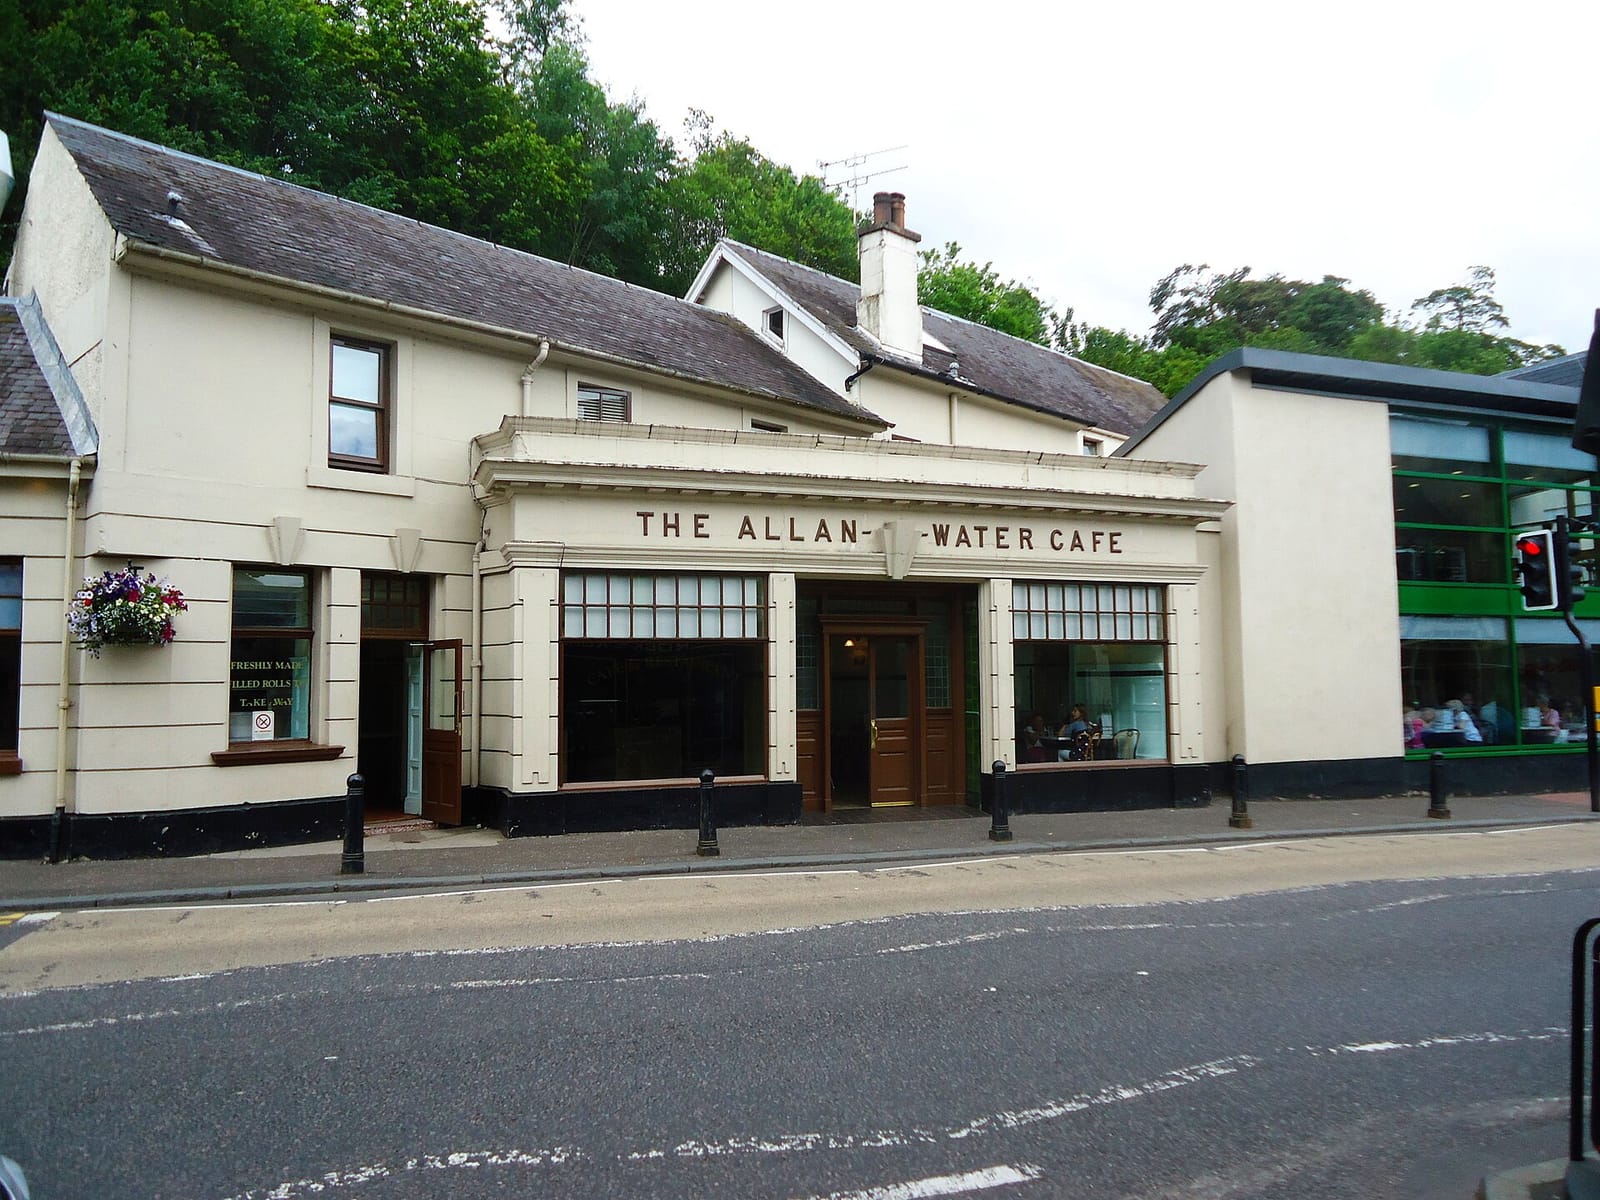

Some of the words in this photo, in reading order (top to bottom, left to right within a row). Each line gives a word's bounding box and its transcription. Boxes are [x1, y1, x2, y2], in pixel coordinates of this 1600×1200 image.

[636, 511, 710, 538] THE
[1050, 529, 1123, 554] CAFE
[231, 661, 273, 670] FRESHLY
[275, 661, 304, 670] MADE
[231, 680, 260, 689] ILLED
[262, 680, 291, 688] ROLLS
[239, 698, 267, 707] TAKE
